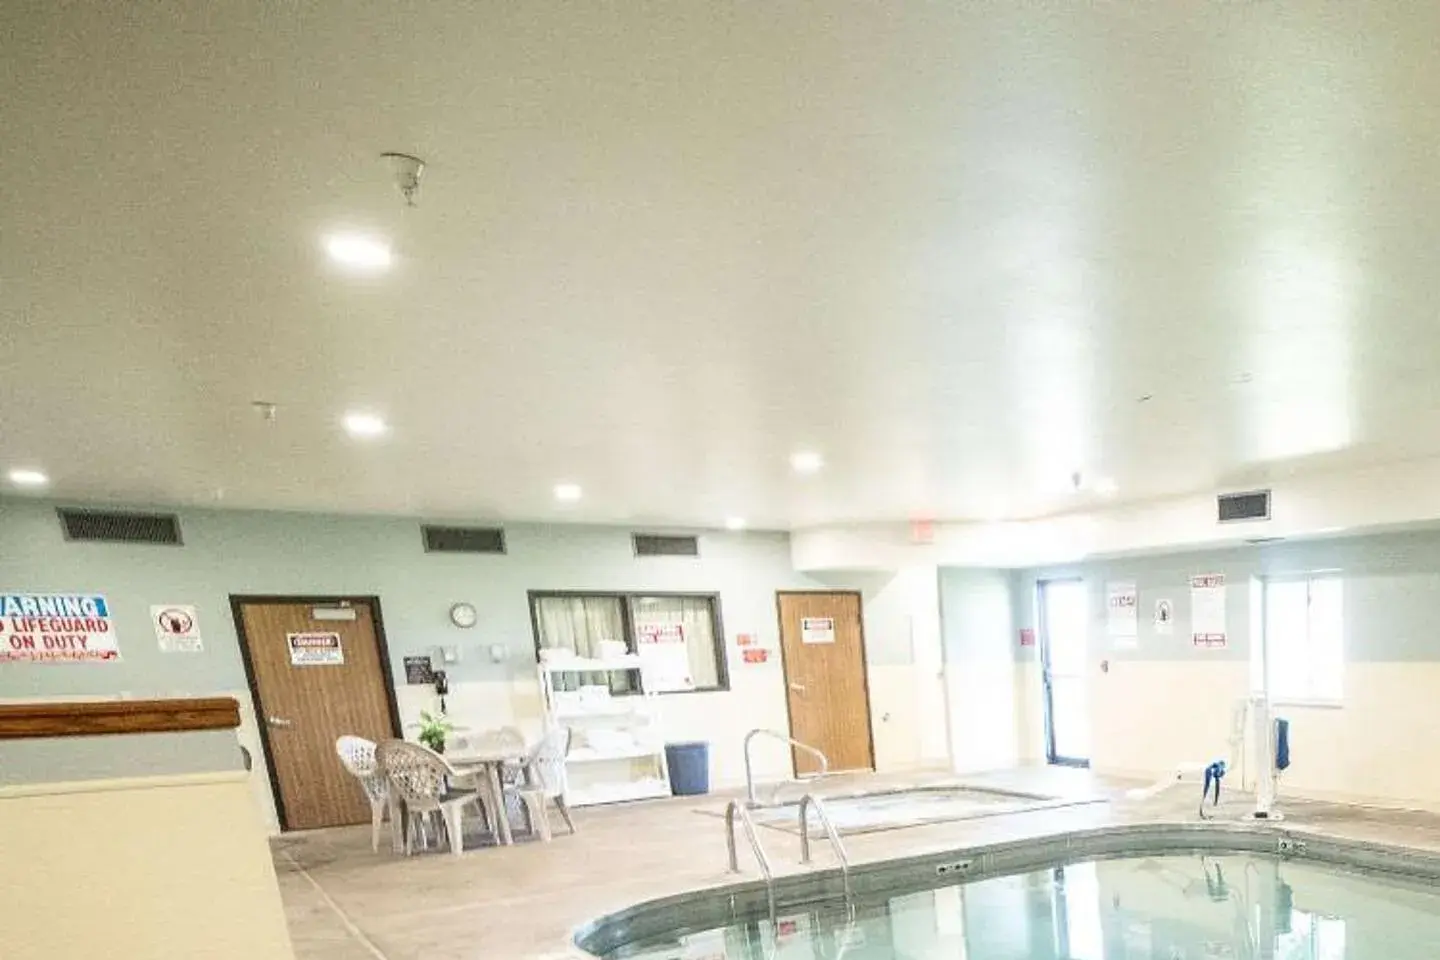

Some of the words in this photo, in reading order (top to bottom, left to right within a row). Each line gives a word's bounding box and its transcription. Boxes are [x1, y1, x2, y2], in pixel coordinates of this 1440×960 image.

[0, 596, 98, 616] ARNING
[12, 617, 109, 633] LIFEGUARD
[9, 634, 36, 650] ON
[42, 634, 88, 650] DUTY
